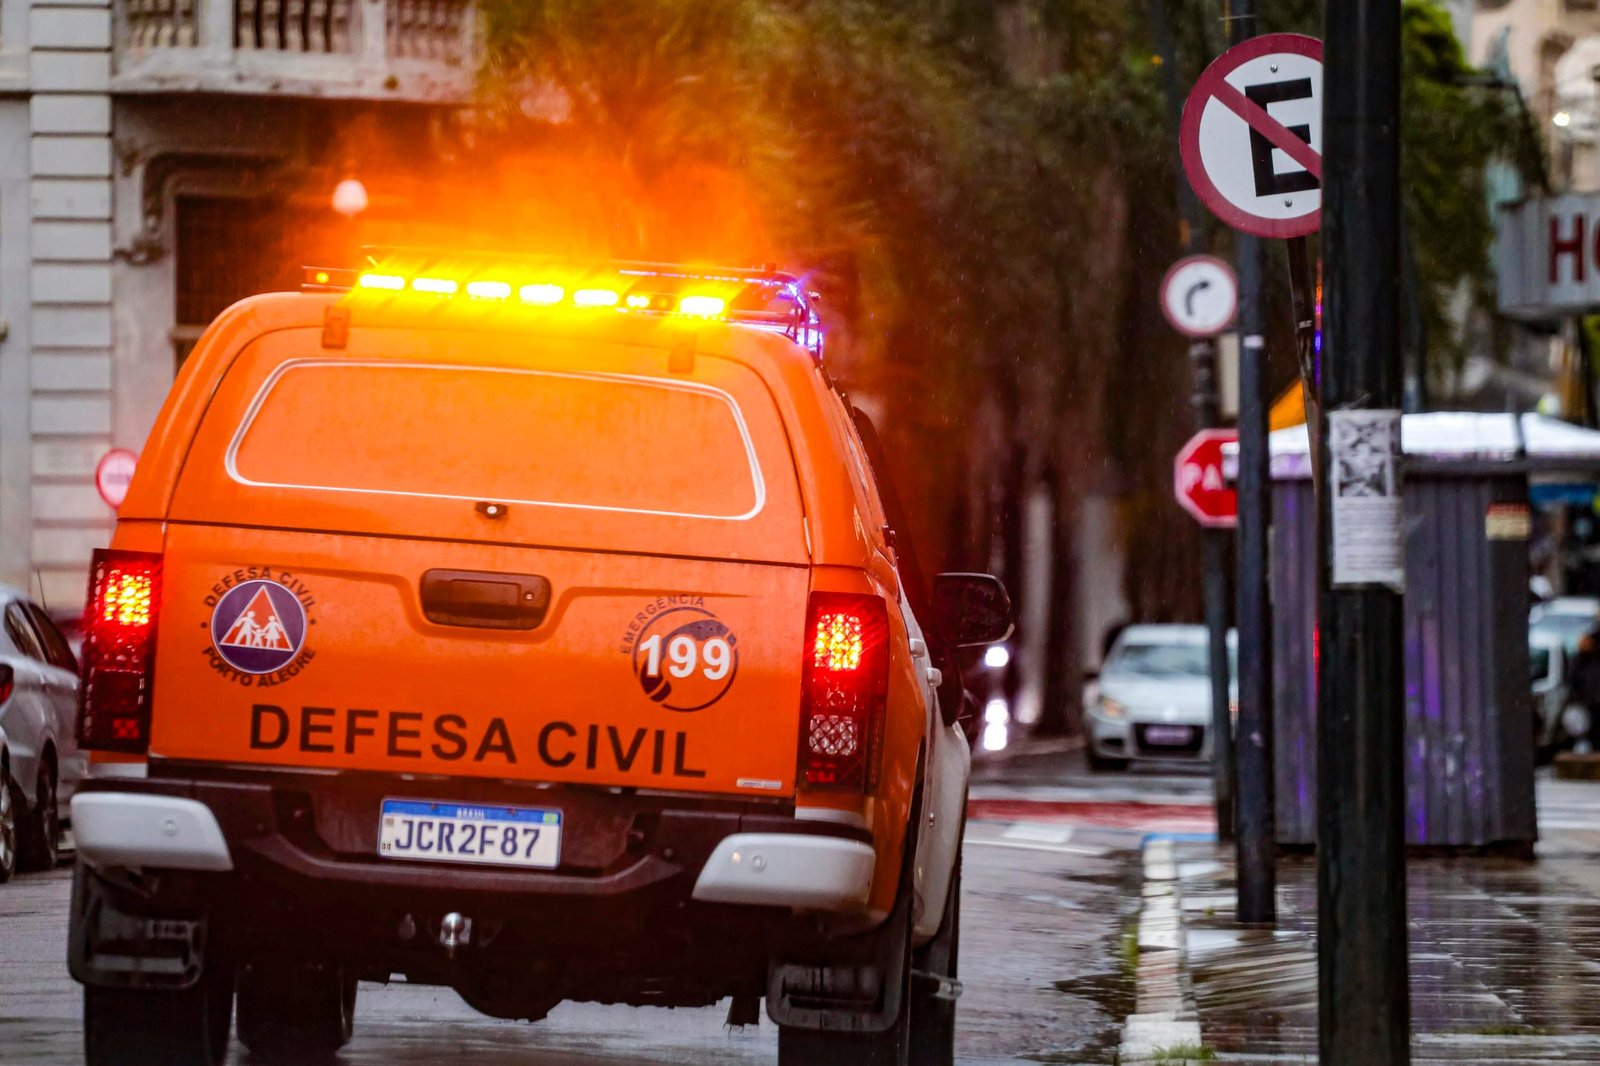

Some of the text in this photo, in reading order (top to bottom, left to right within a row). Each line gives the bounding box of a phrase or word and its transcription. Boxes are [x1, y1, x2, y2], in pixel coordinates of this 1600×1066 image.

[1244, 77, 1322, 197] E
[1548, 212, 1600, 285] H
[203, 566, 316, 613] DEFESA CIVIL
[202, 646, 318, 688] PORTO ALEGRE
[640, 634, 731, 681] 199
[249, 703, 707, 779] DEFESA CIVIL
[394, 819, 541, 859] JCR2F87
